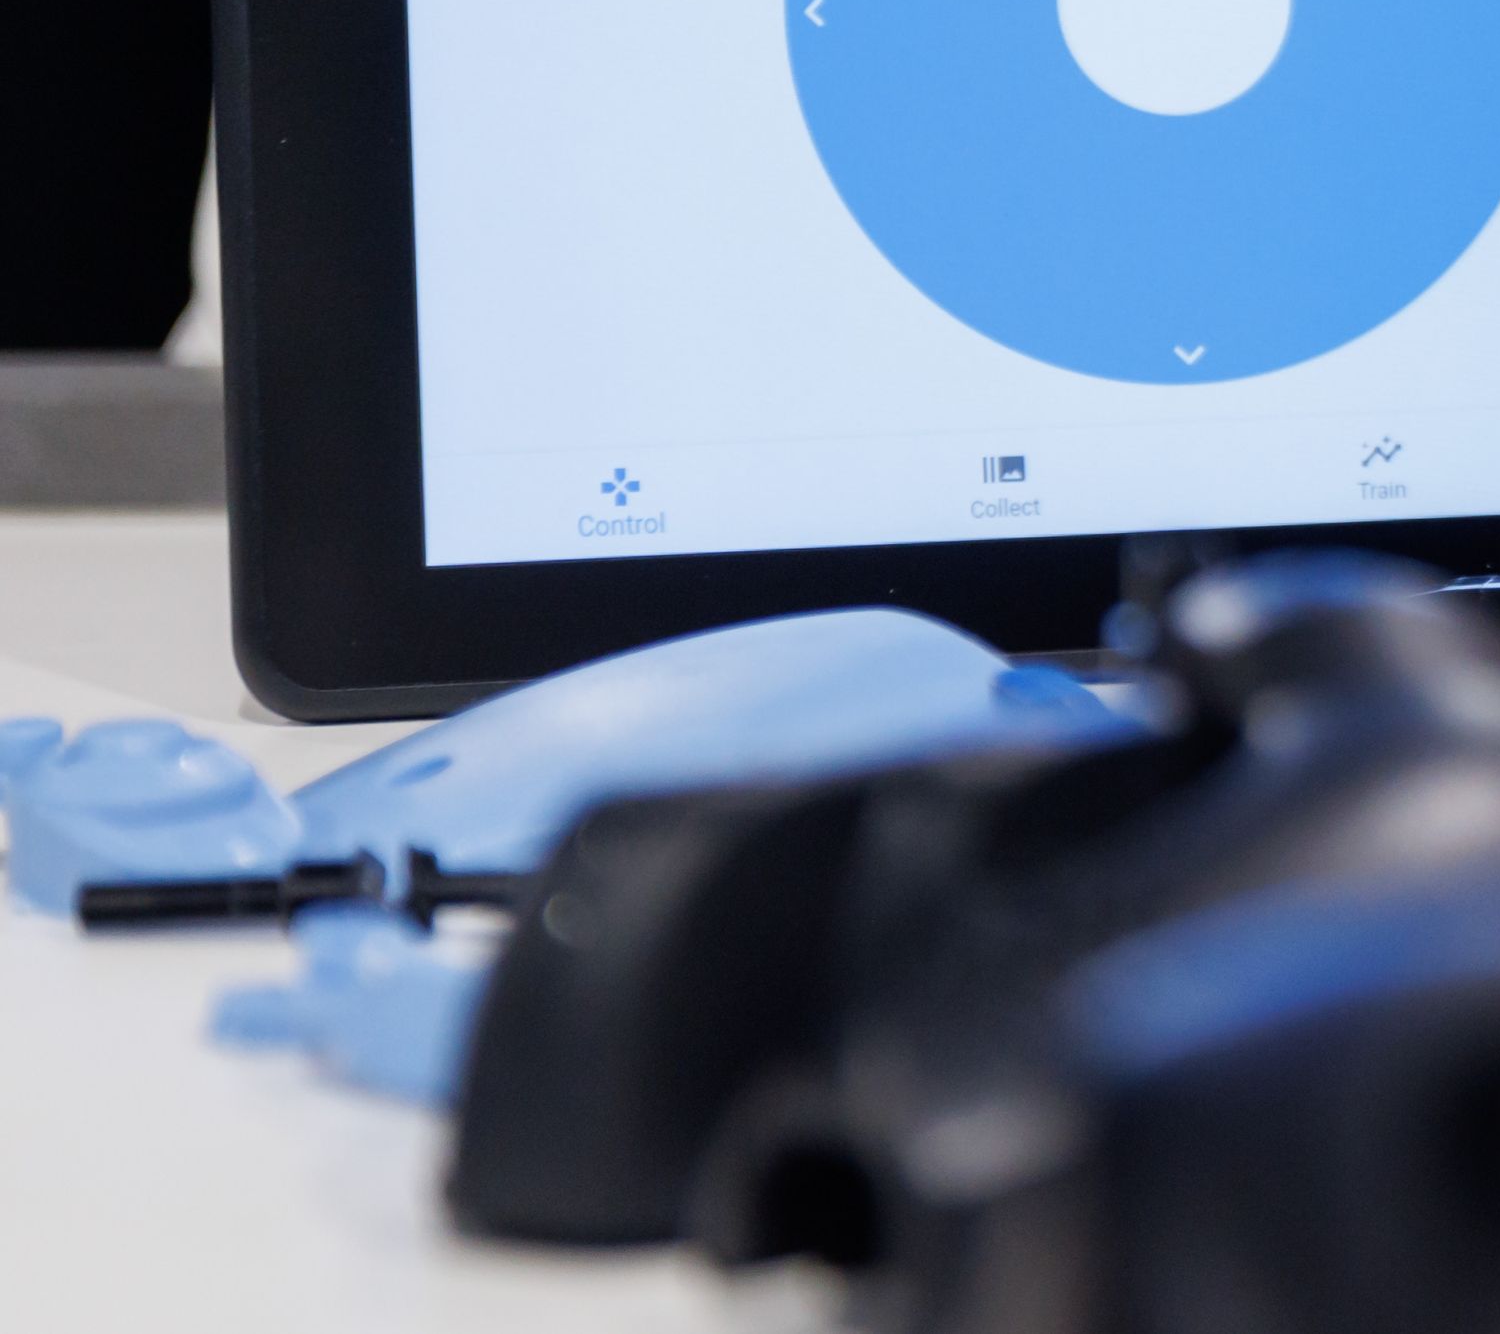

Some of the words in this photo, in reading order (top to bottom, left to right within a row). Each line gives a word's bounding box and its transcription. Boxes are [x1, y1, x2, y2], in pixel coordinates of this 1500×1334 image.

[1357, 481, 1408, 500] Train
[970, 496, 1042, 519] Collect
[577, 510, 666, 538] Control
